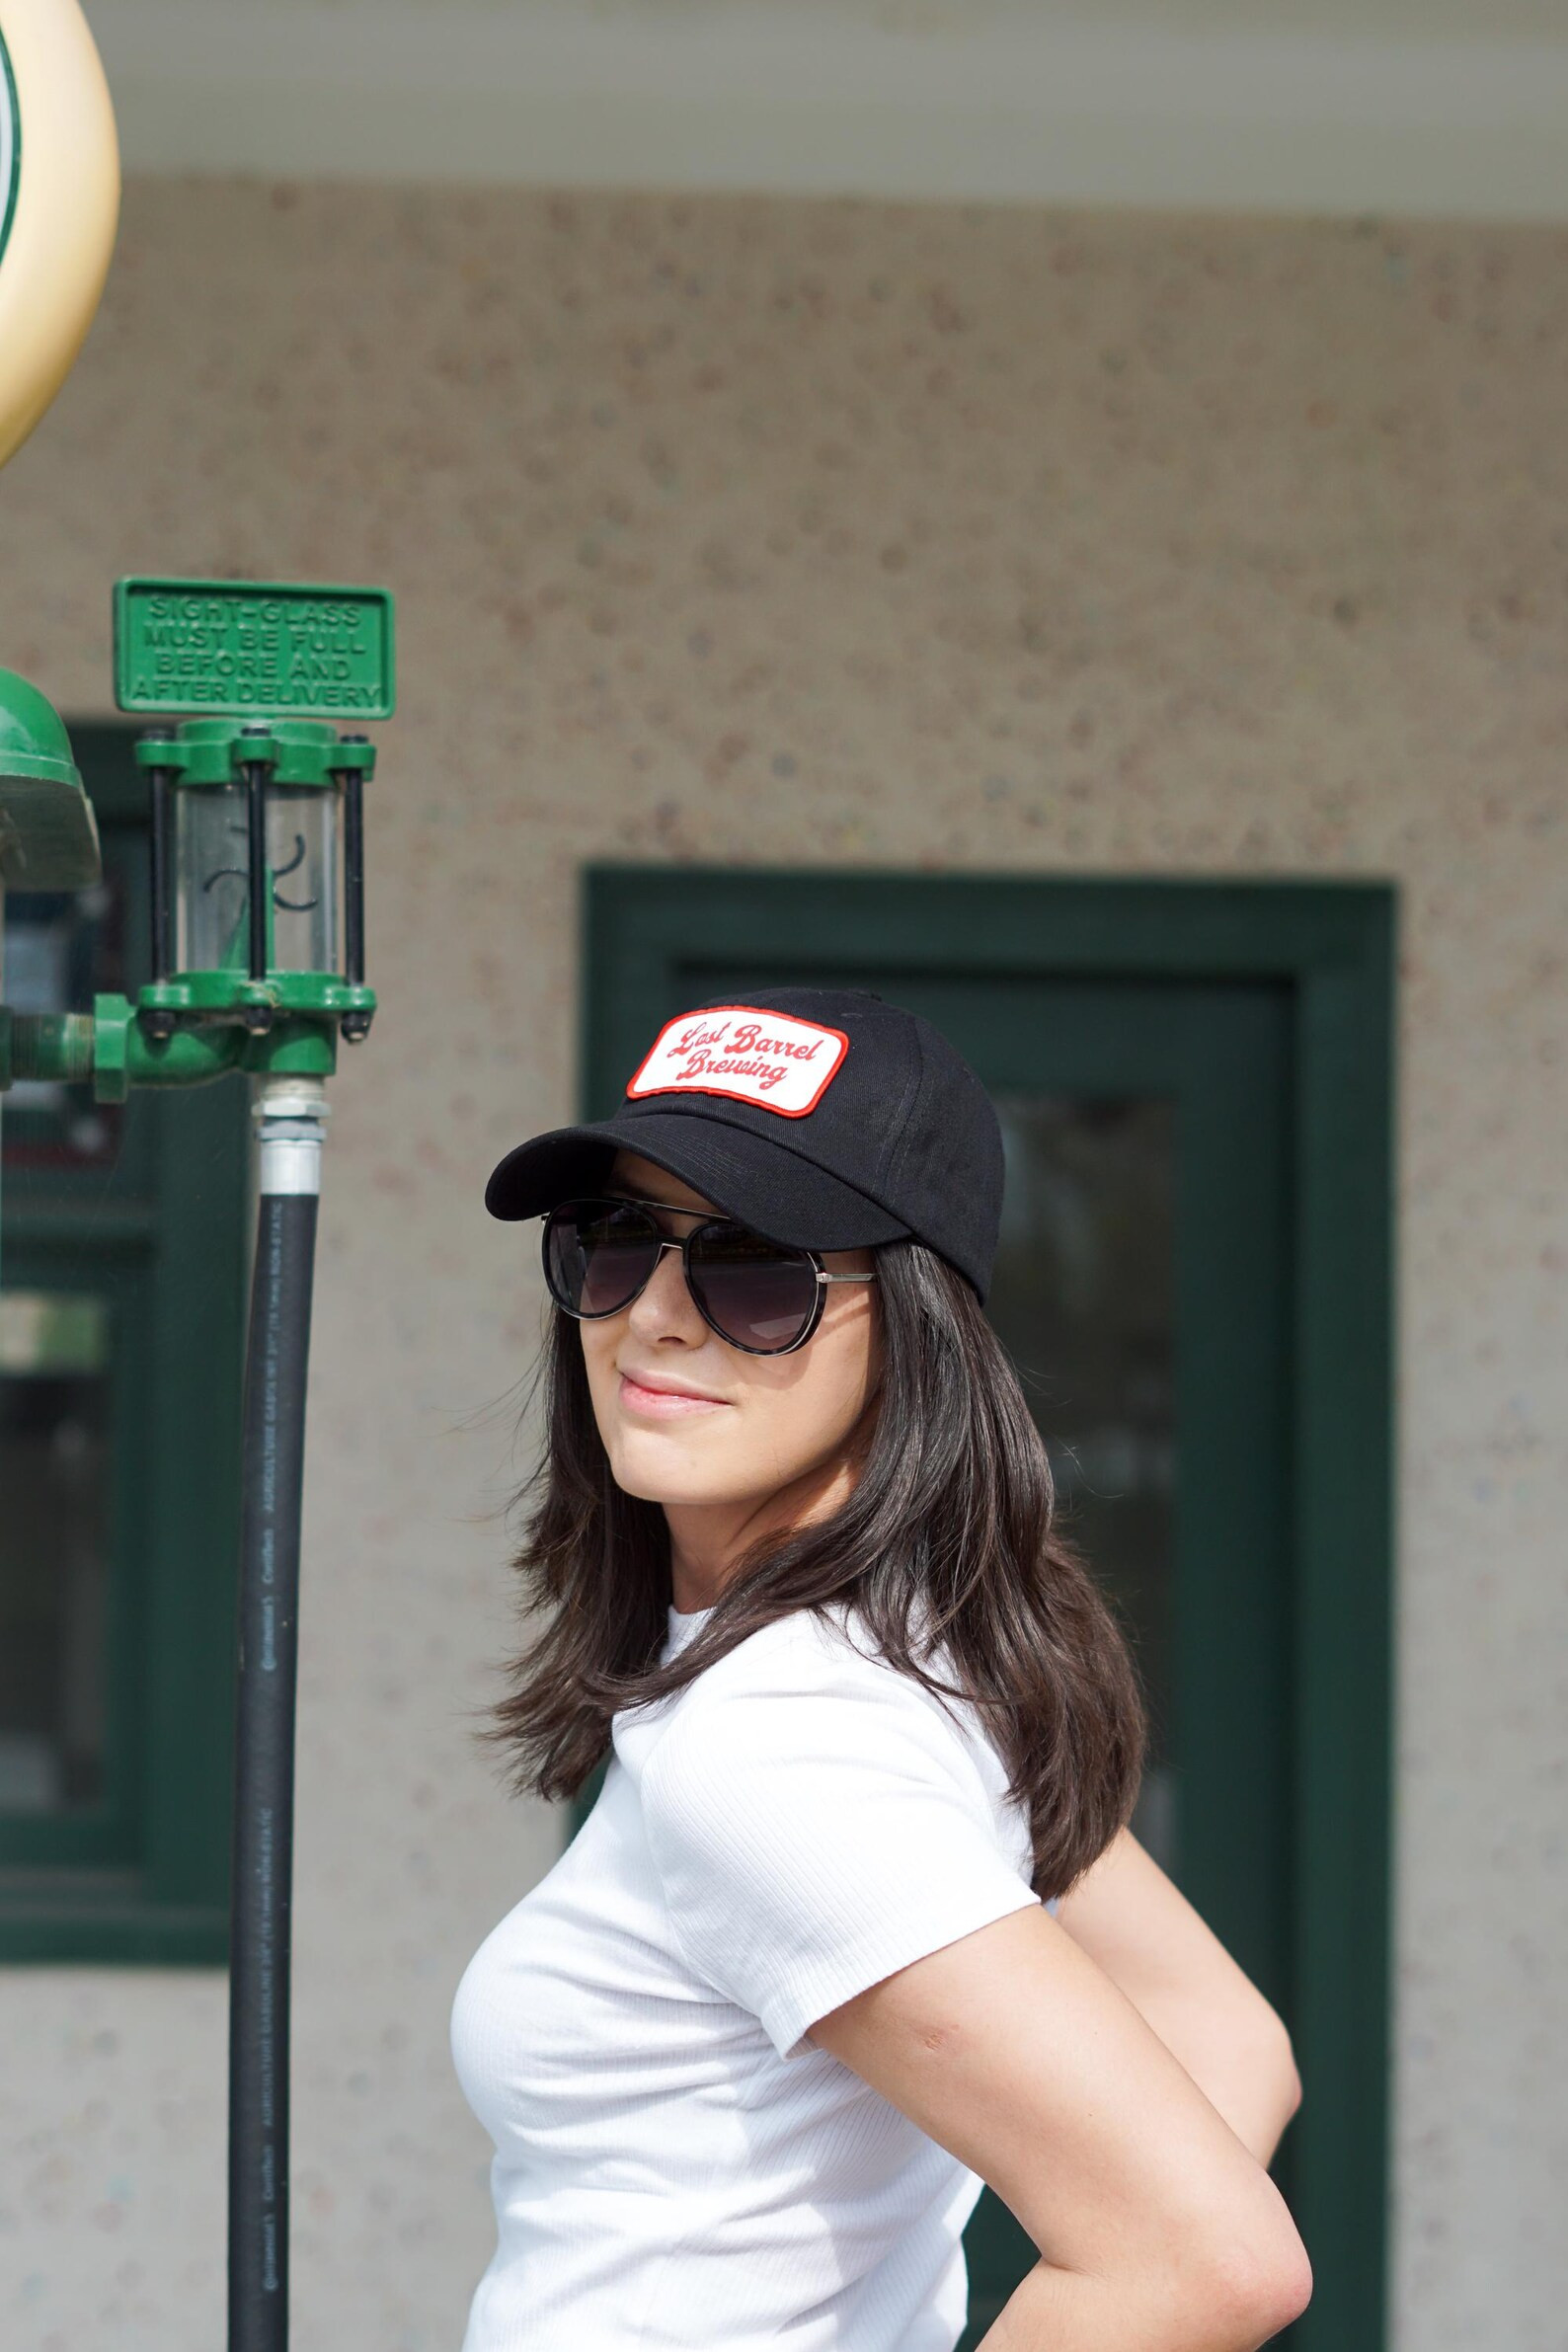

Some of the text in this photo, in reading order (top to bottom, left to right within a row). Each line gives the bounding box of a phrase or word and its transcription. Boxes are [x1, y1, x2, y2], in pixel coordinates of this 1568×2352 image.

[144, 623, 366, 655] MUST BE FULL
[155, 651, 352, 680] BEFORE AND
[132, 677, 381, 708] AFTER DELIVERY
[724, 1024, 824, 1060] Barrel
[675, 1049, 789, 1090] Brewing
